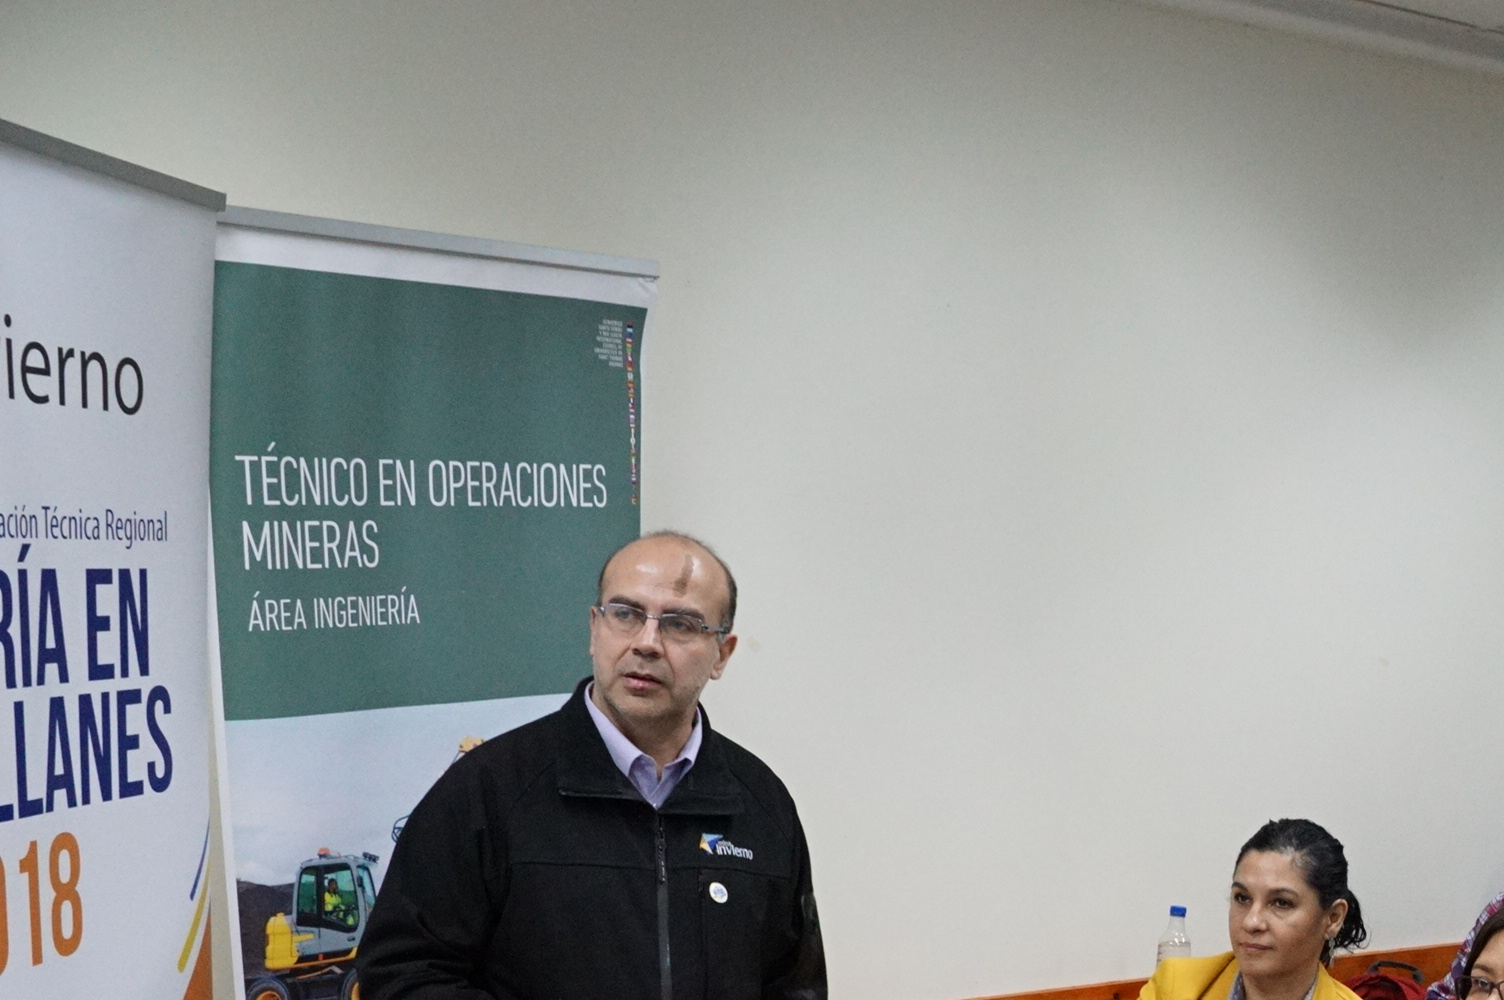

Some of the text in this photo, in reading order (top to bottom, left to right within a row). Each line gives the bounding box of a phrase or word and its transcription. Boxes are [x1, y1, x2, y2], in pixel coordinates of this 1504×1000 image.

[4, 314, 144, 416] ierno
[235, 441, 608, 508] TÉCNICO EN OPERACIONES
[41, 505, 100, 541] Técnica
[105, 508, 168, 550] Regional
[242, 519, 380, 570] MINERAS
[86, 568, 149, 681] EN
[248, 585, 421, 632] ÁREA INGENIERÍA
